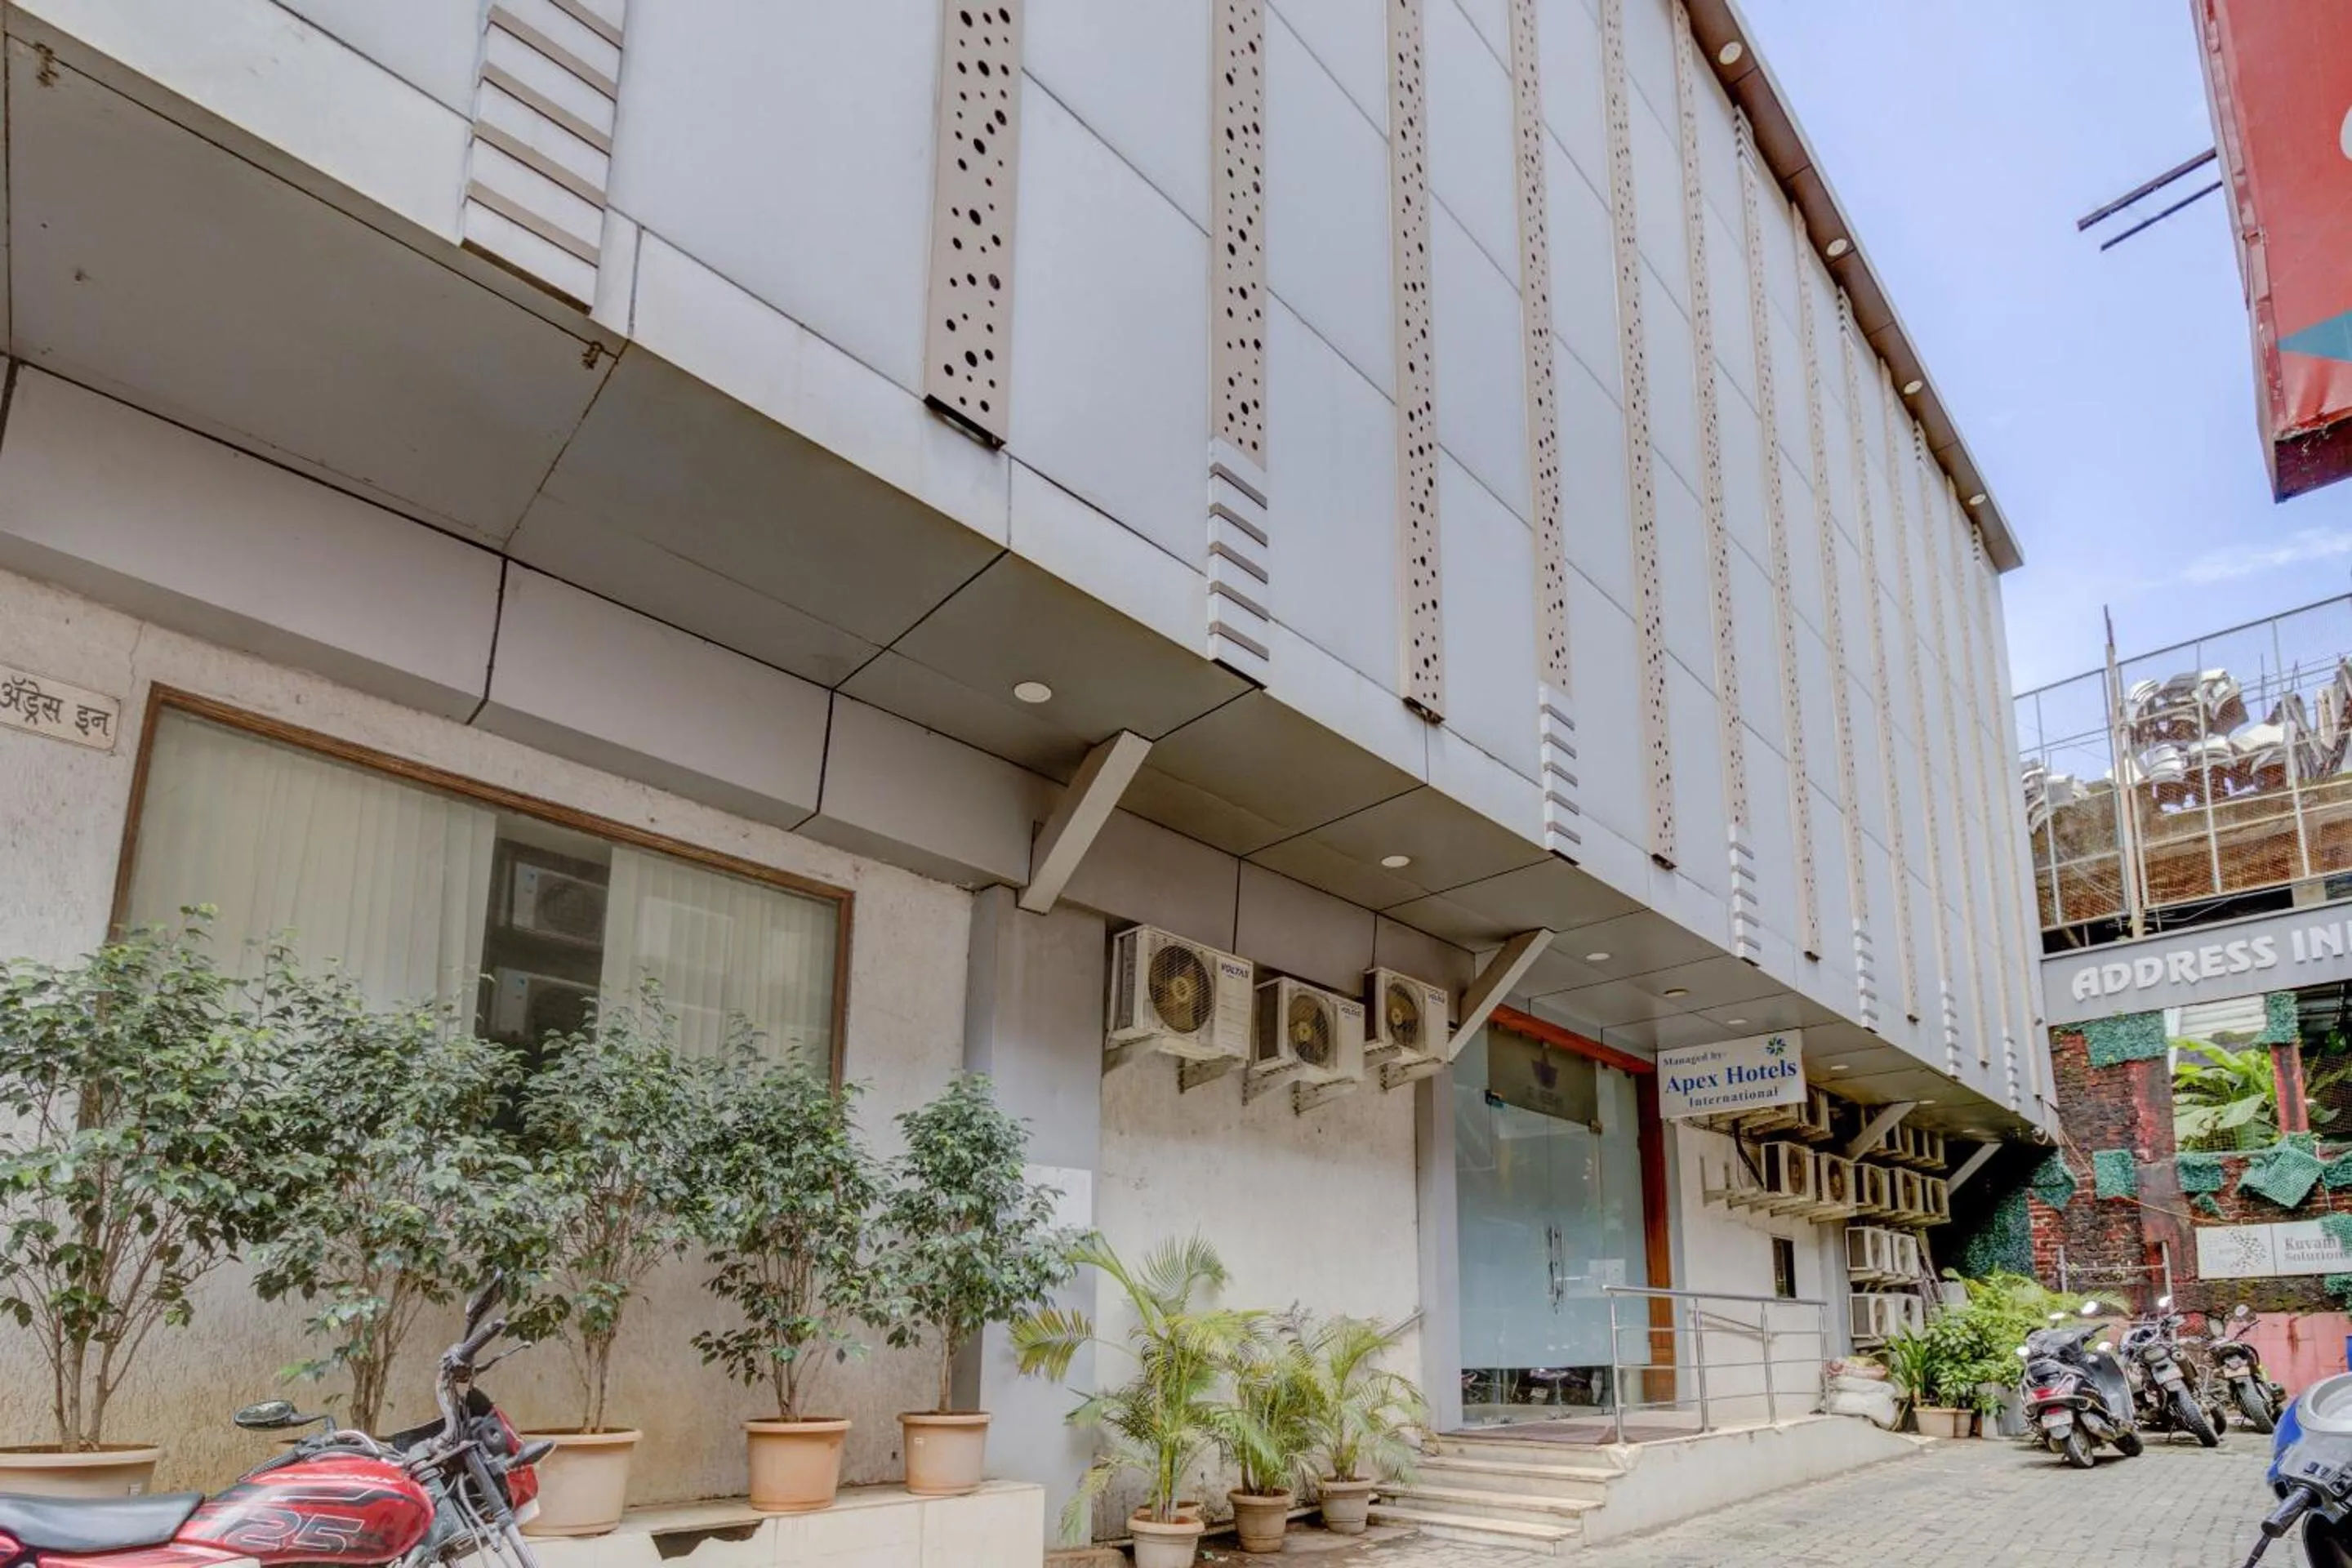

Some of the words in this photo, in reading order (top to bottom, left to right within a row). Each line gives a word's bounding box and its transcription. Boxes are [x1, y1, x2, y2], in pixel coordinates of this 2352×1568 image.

[75, 704, 112, 736] इन
[2072, 936, 2278, 1002] ADDRESS
[1663, 1052, 1708, 1067] Managed
[1665, 1073, 1718, 1096] Apex
[1726, 1060, 1797, 1085] Hotels
[1690, 1087, 1779, 1108] International
